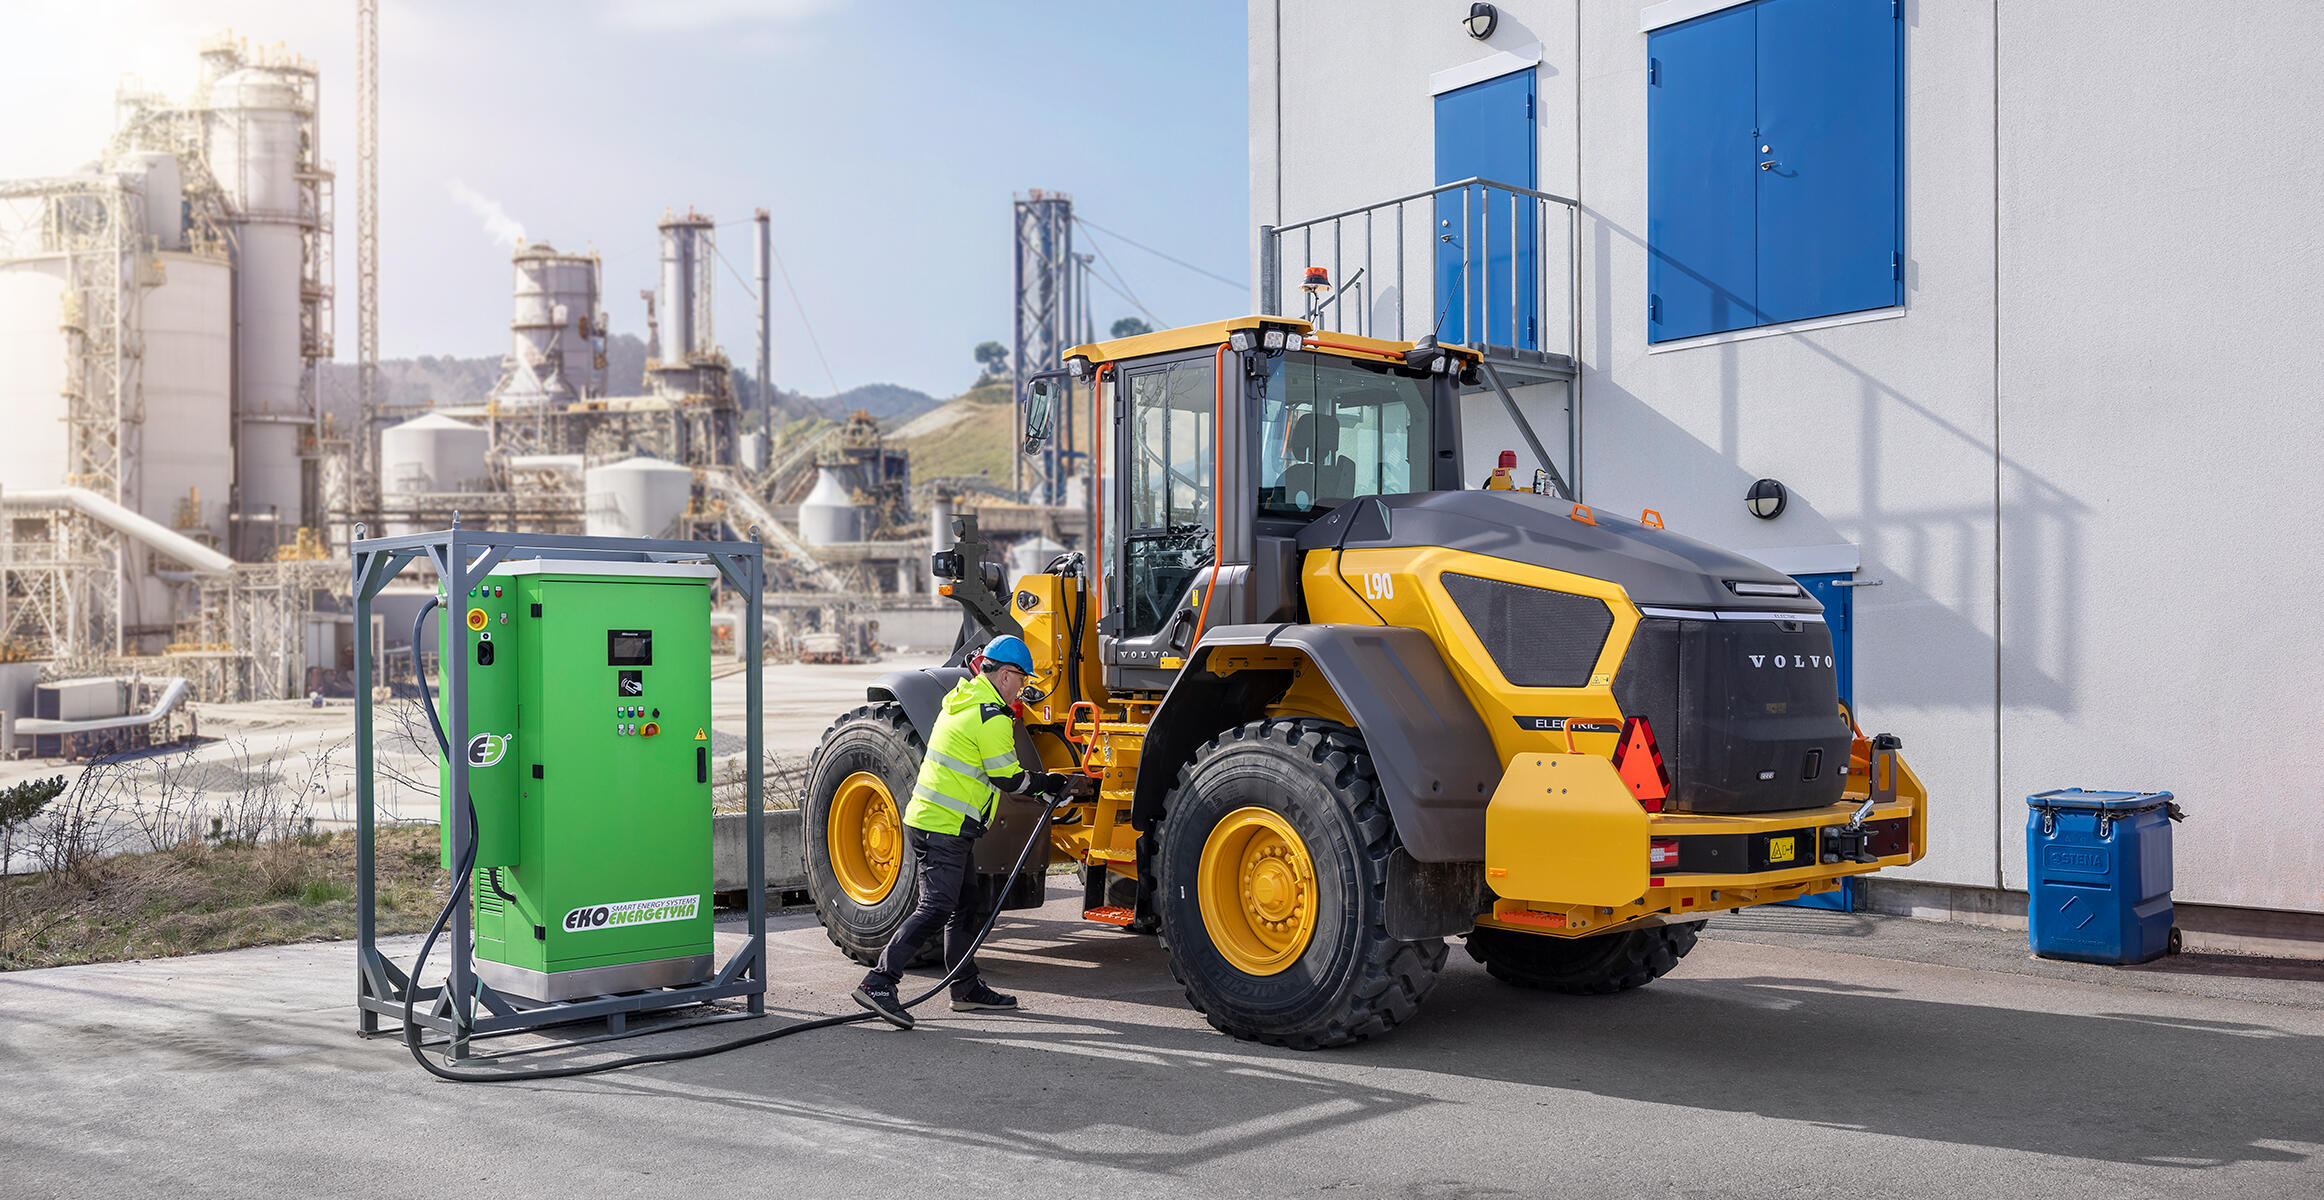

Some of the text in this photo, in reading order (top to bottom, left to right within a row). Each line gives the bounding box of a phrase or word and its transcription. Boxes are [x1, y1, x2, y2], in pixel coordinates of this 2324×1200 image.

[1364, 573, 1394, 599] L90
[1120, 651, 1169, 659] VOLVO
[1748, 655, 1833, 668] VOLVO
[2061, 850, 2103, 867] STENA
[611, 897, 697, 912] SMART ENERGY SYSTEMS
[565, 904, 696, 929] EKO ENERGETYKA
